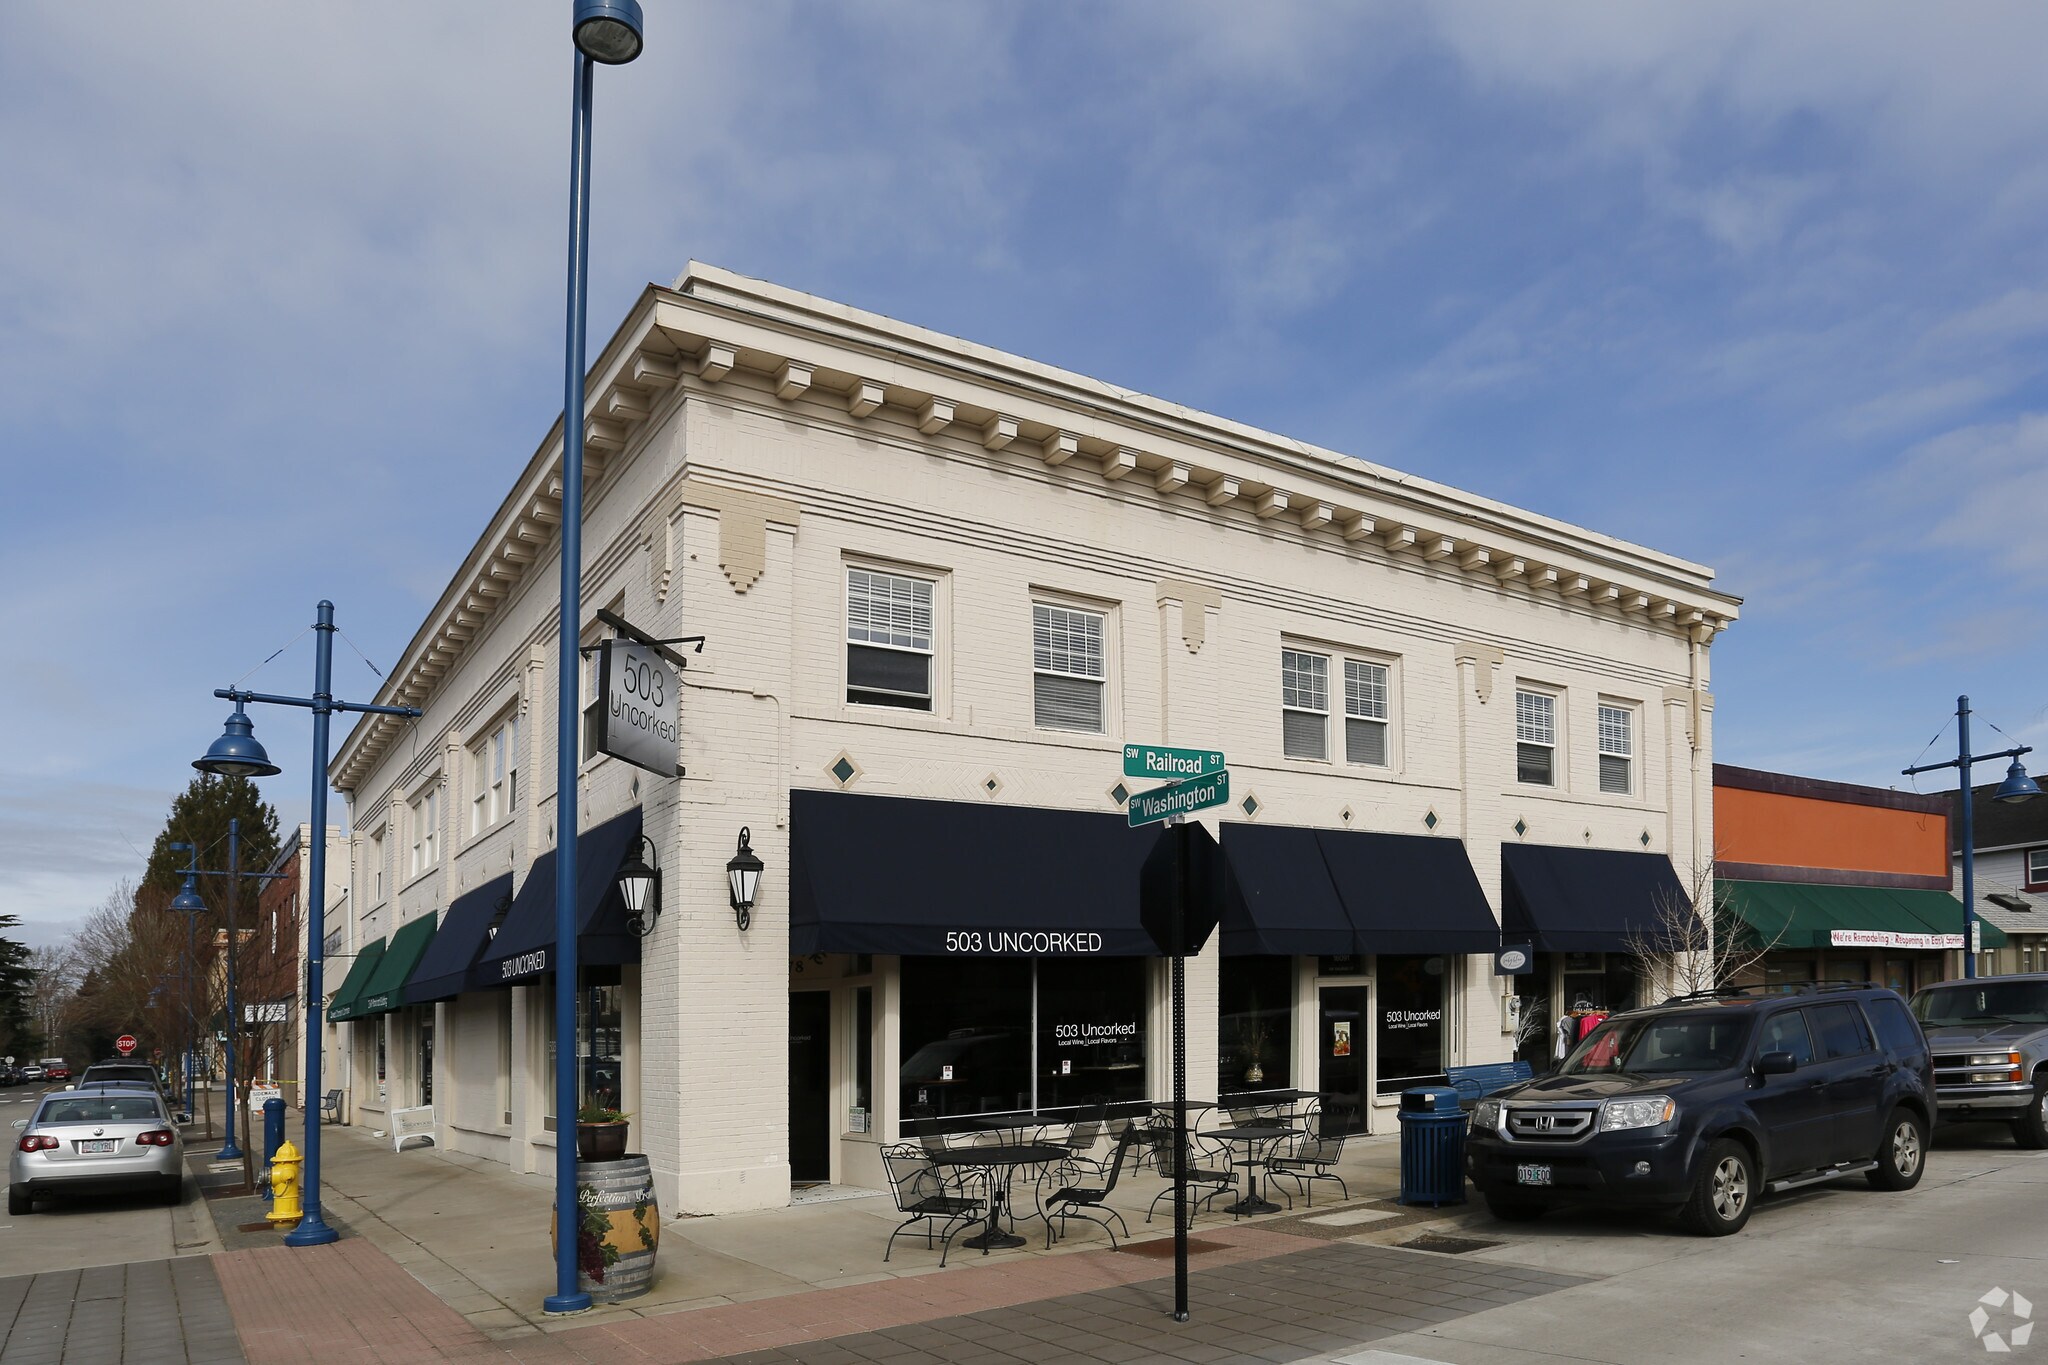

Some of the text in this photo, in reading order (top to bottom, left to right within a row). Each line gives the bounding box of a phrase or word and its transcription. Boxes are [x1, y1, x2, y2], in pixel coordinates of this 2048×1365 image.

[624, 653, 664, 707] 503
[611, 690, 676, 743] Uncorked
[1126, 748, 1221, 774] SW Railroad ST
[1130, 774, 1227, 817] SW Washington ST
[946, 931, 1102, 952] 503 UNCORKED
[1832, 931, 1852, 942] We're
[1853, 932, 1889, 945] Remodeling
[502, 950, 546, 979] 503 UNCORKED
[1387, 1009, 1441, 1022] 503 Uncorked
[1056, 1022, 1135, 1038] 503 Uncorked
[578, 1190, 627, 1207] Perfection
